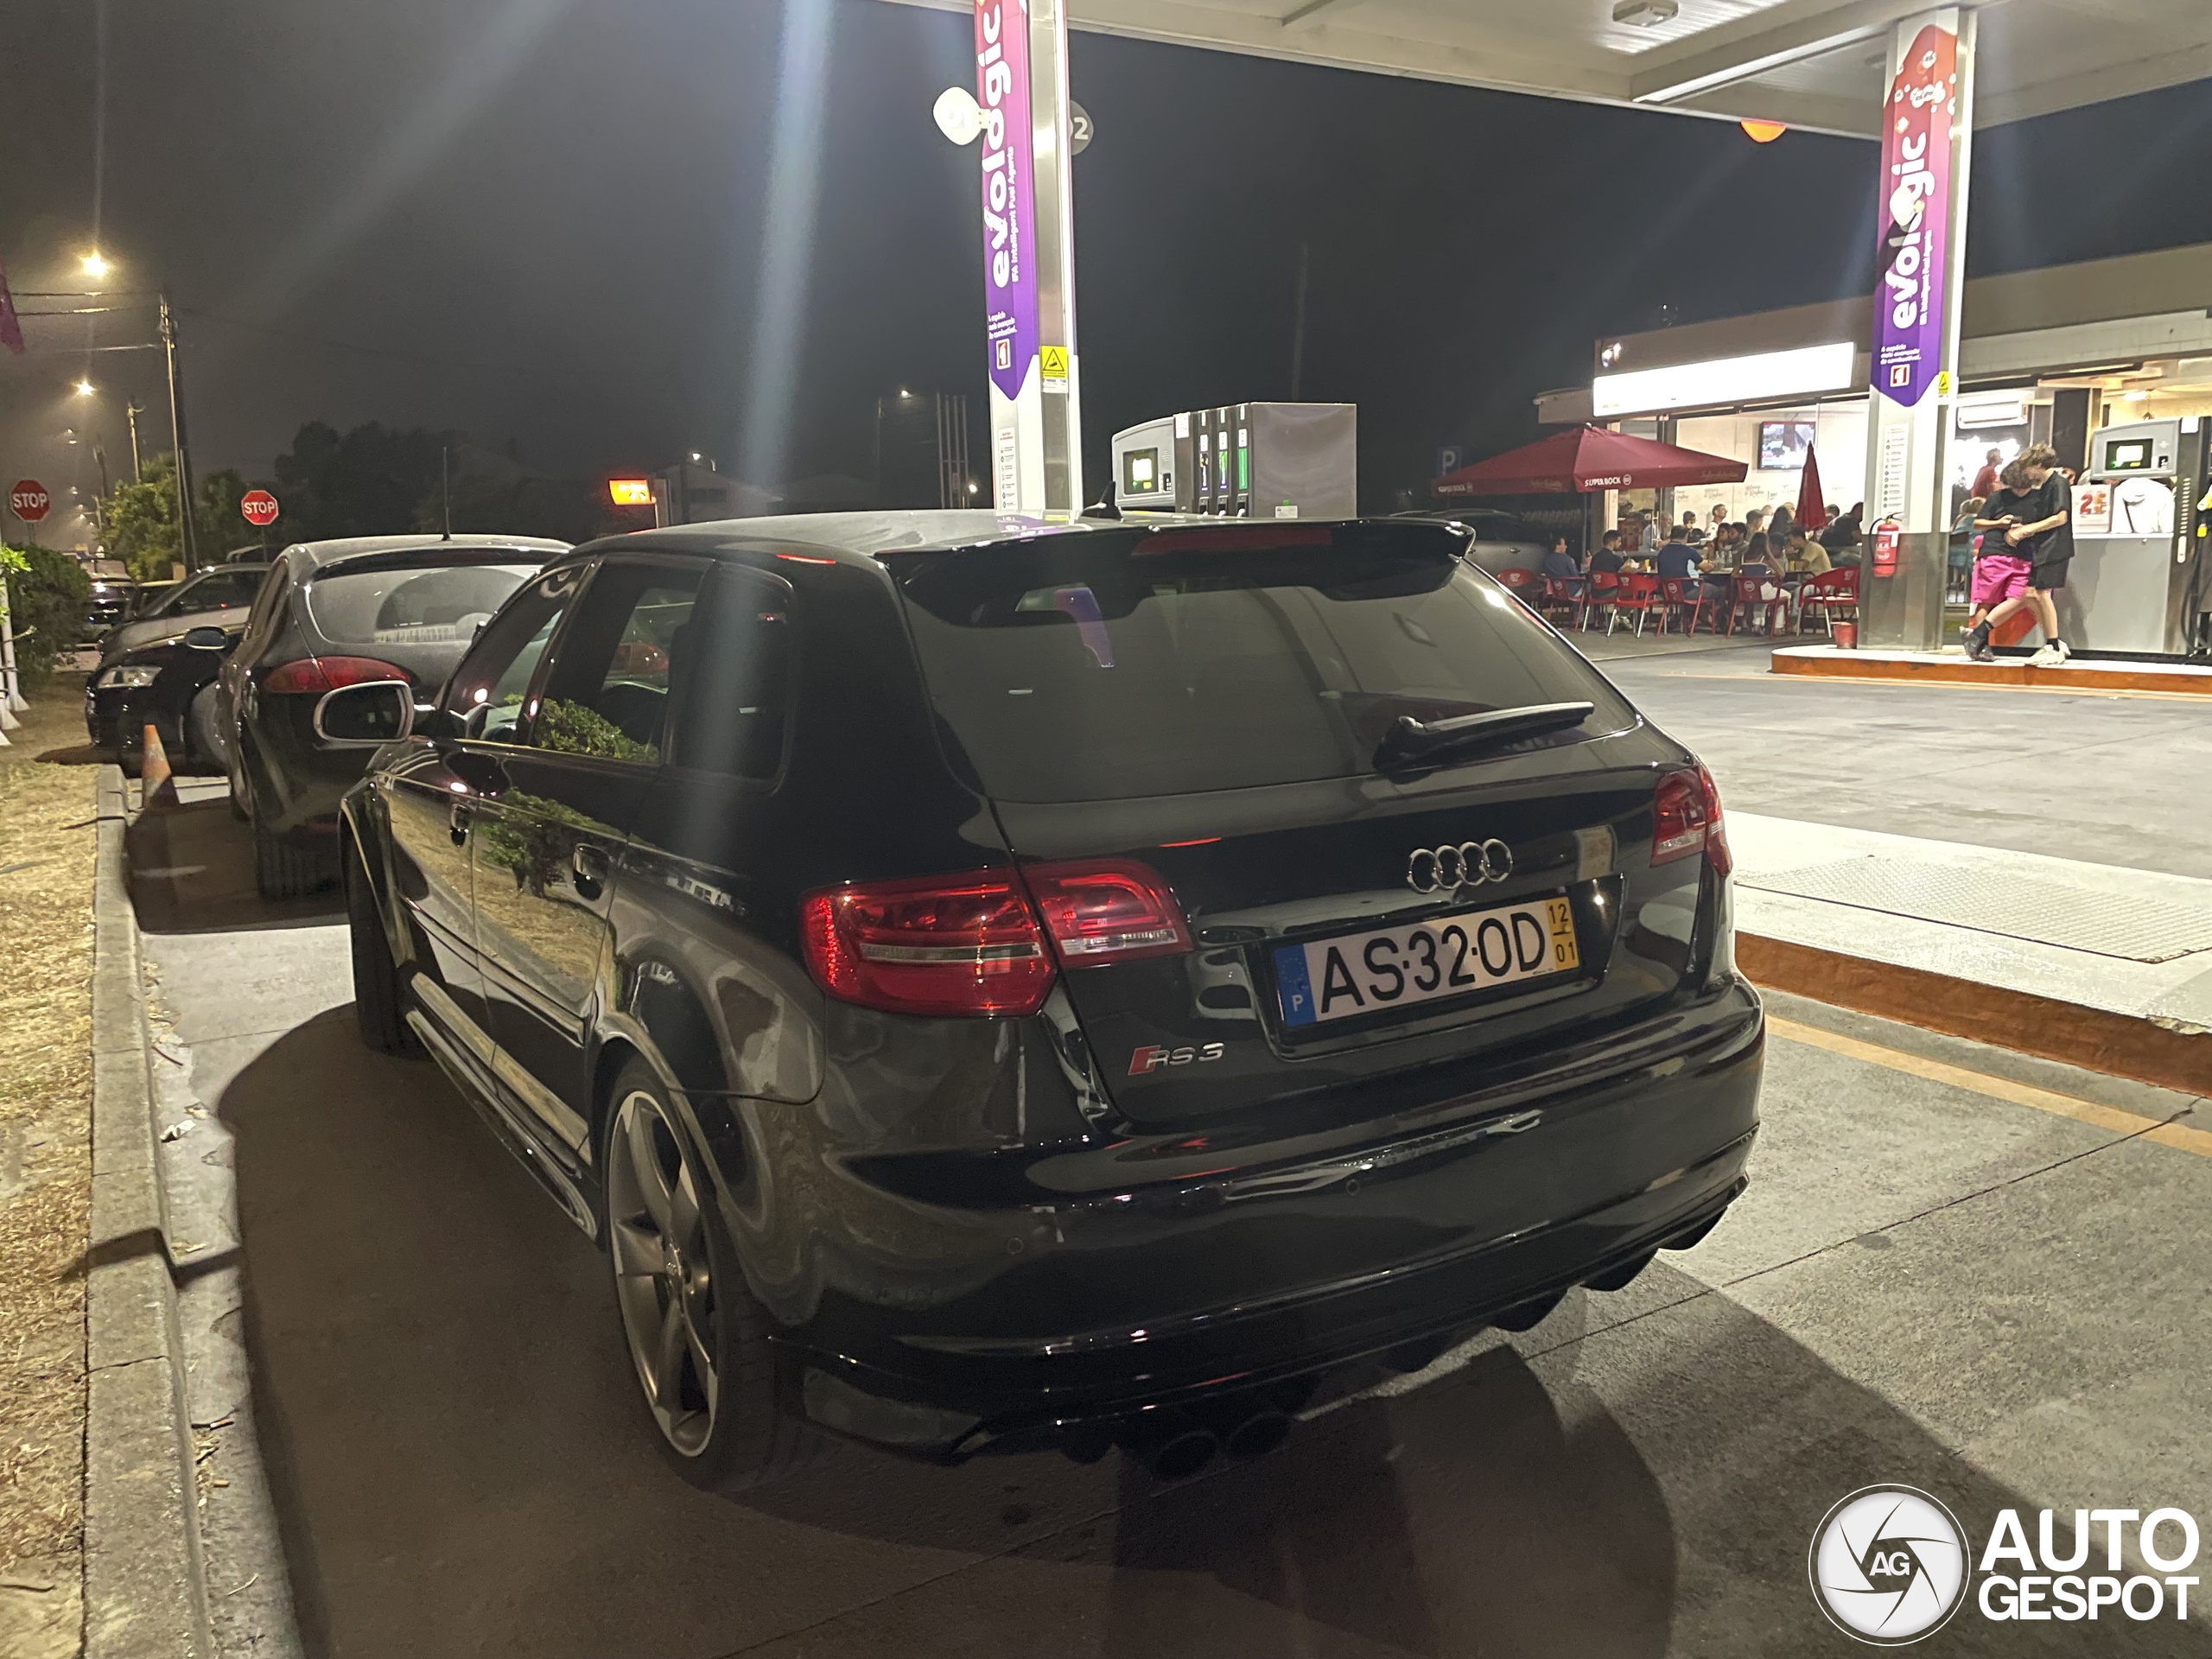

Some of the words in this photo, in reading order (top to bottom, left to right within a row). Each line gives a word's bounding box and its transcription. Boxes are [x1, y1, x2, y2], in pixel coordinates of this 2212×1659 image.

[1073, 117, 1089, 140] 2
[977, 4, 1012, 288] evologic
[1007, 146, 1016, 184] Agents
[1007, 186, 1016, 208] Fuel
[1008, 210, 1020, 263] Intelligent
[1442, 450, 1456, 476] P
[1585, 477, 1605, 486] SUPER
[1605, 476, 1621, 485] BOCK
[11, 492, 48, 509] STOP
[244, 502, 276, 515] STOP
[1548, 903, 1569, 925] 12
[1554, 940, 1577, 963] 01
[1292, 994, 1305, 1013] P
